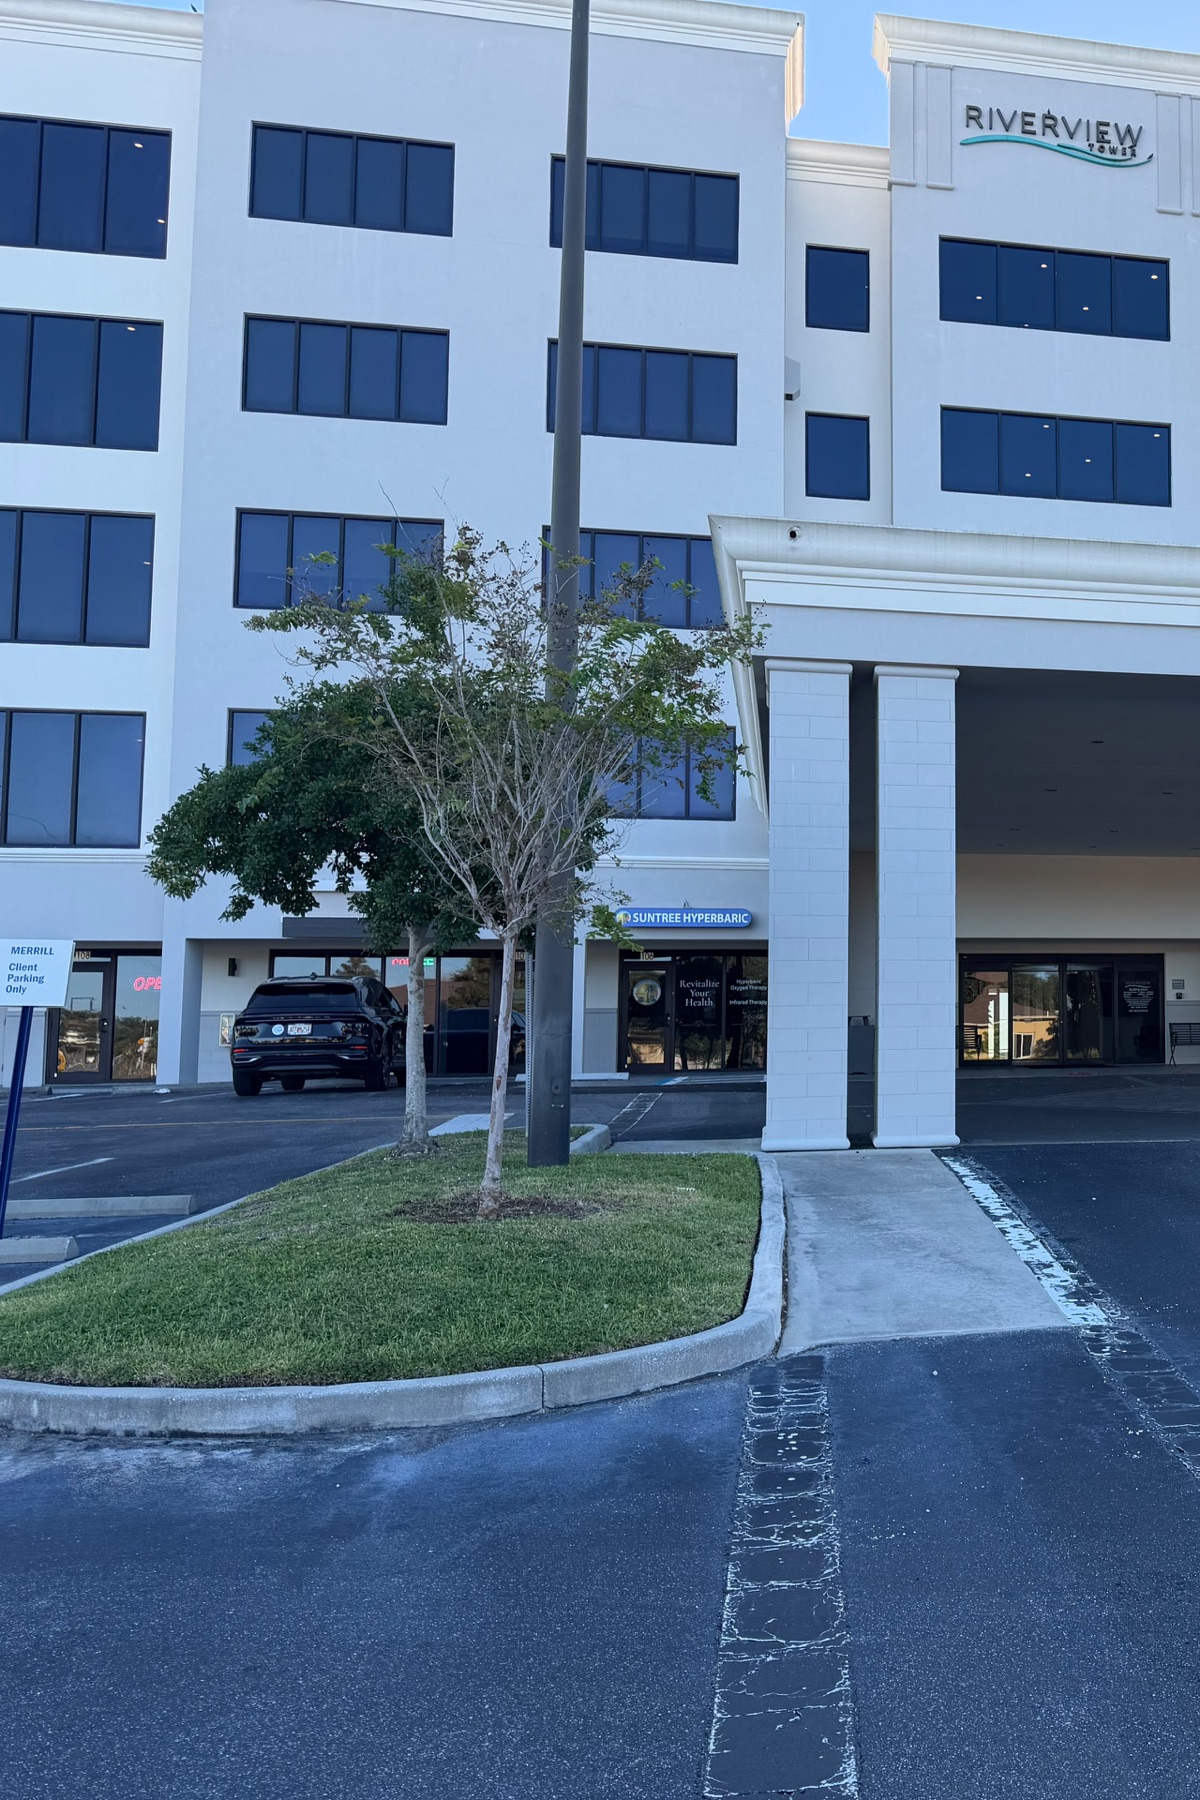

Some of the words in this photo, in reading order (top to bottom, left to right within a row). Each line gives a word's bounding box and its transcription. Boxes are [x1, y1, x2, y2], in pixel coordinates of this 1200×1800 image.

[965, 104, 1144, 146] RIVERVIEW
[1087, 143, 1138, 158] TOWER
[632, 912, 682, 923] SUNTREE
[683, 912, 749, 924] HYPERBARIC
[10, 946, 54, 955] MERRILL
[8, 962, 38, 971] Client
[7, 973, 45, 984] Parking
[133, 976, 162, 991] OPE
[680, 979, 720, 988] Revitalize
[5, 984, 27, 995] Only
[689, 989, 710, 997] Your
[685, 998, 713, 1006] Health
